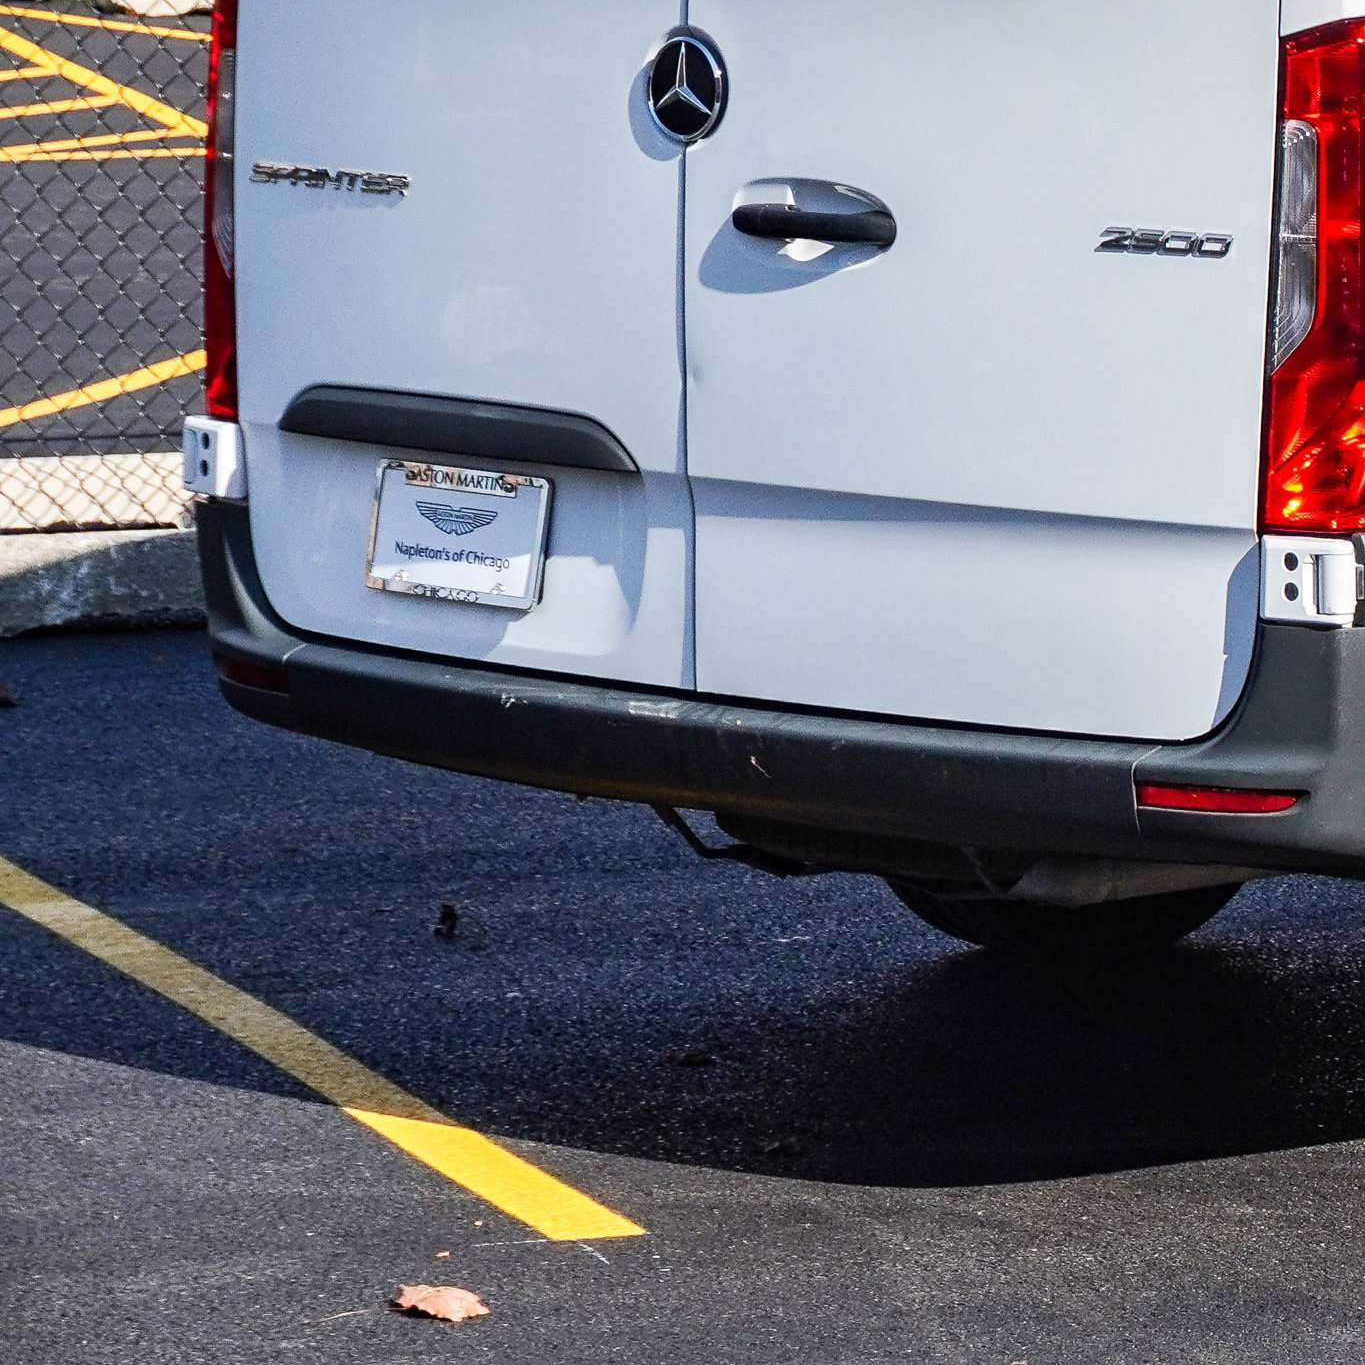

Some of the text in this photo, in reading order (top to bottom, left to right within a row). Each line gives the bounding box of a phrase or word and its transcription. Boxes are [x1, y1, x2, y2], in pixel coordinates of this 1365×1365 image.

[249, 164, 411, 195] SPRINTER
[1094, 226, 1234, 259] 2500
[417, 466, 505, 492] ASTON MARTIN
[394, 540, 510, 572] Napleton's of Chicago
[413, 584, 478, 603] CHICAGO
